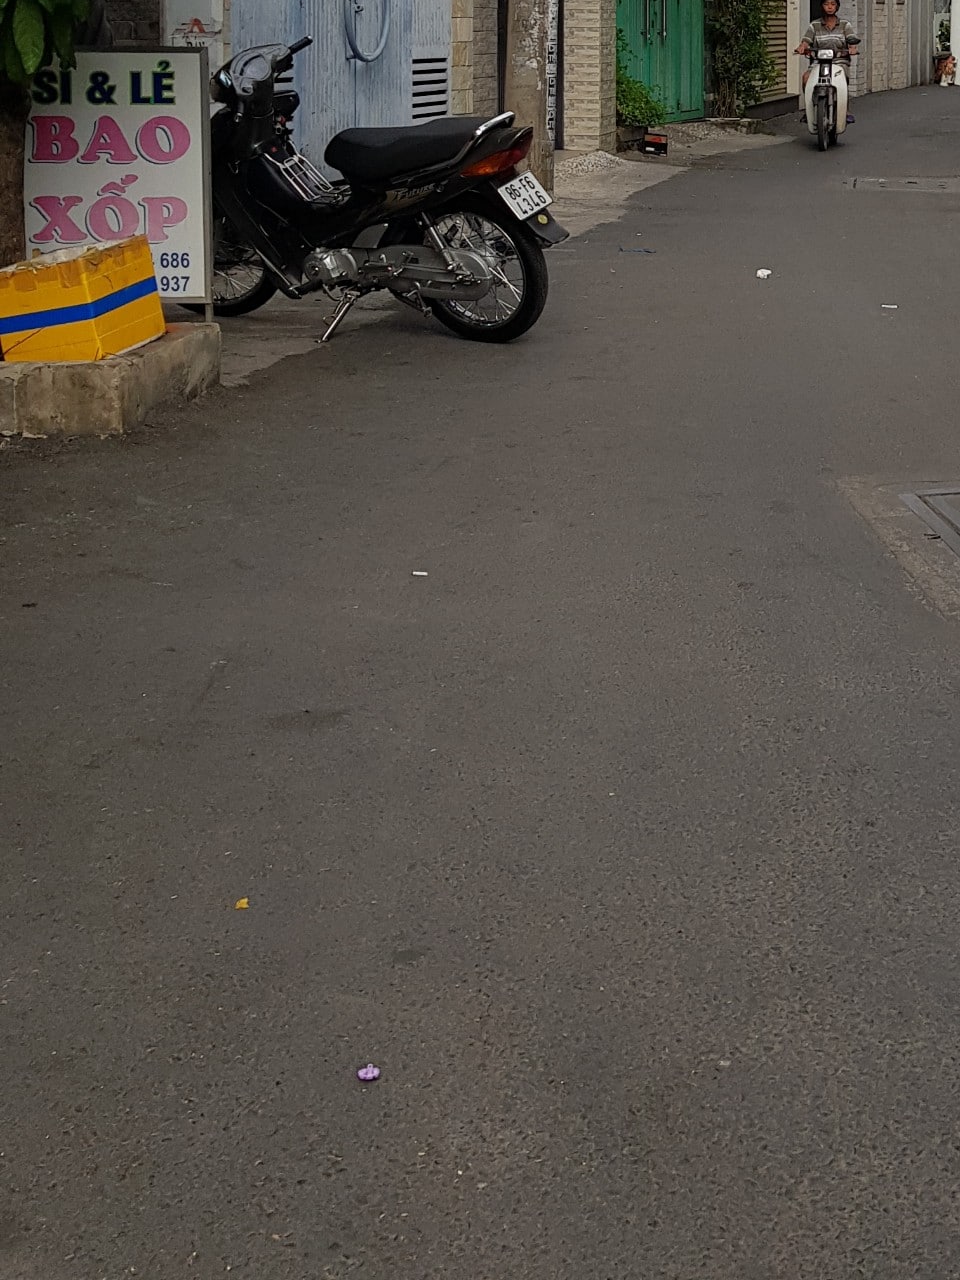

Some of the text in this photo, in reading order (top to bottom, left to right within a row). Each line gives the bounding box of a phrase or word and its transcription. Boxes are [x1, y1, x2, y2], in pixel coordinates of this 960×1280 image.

[86, 70, 117, 106] &
[130, 60, 177, 106] LẺ
[28, 115, 191, 164] BAO
[29, 174, 188, 244] XỐP
[160, 252, 190, 269] 686
[160, 275, 190, 292] 937
